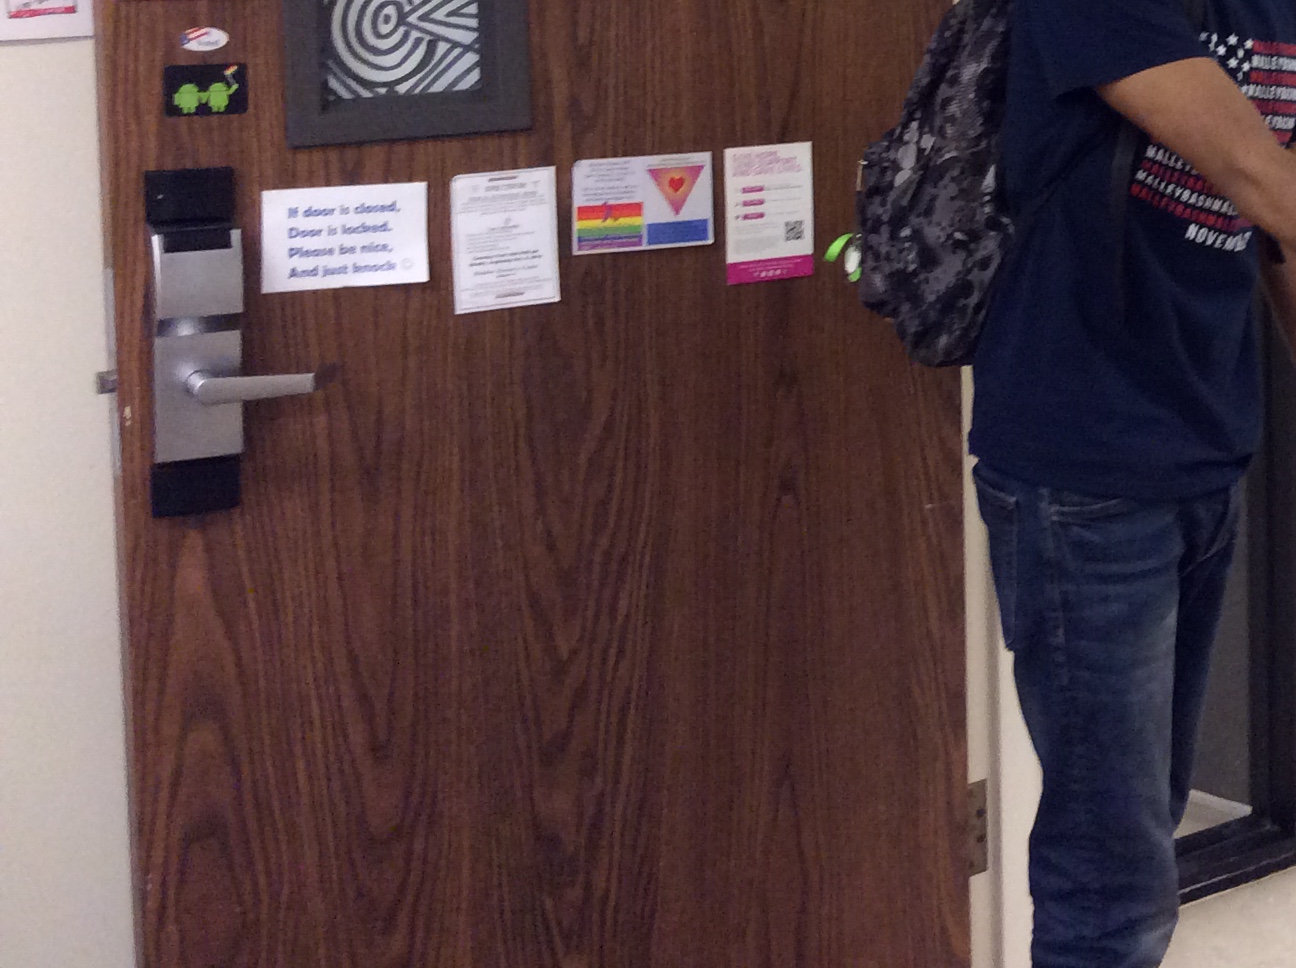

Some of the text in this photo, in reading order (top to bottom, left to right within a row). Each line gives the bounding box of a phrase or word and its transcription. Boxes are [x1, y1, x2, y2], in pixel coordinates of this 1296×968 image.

[288, 206, 299, 218] If
[303, 205, 337, 218] door
[339, 204, 350, 216] is
[288, 226, 323, 239] Door
[327, 225, 337, 236] is
[288, 246, 336, 258] Please
[339, 244, 357, 255] be
[289, 260, 397, 279] And just knock
